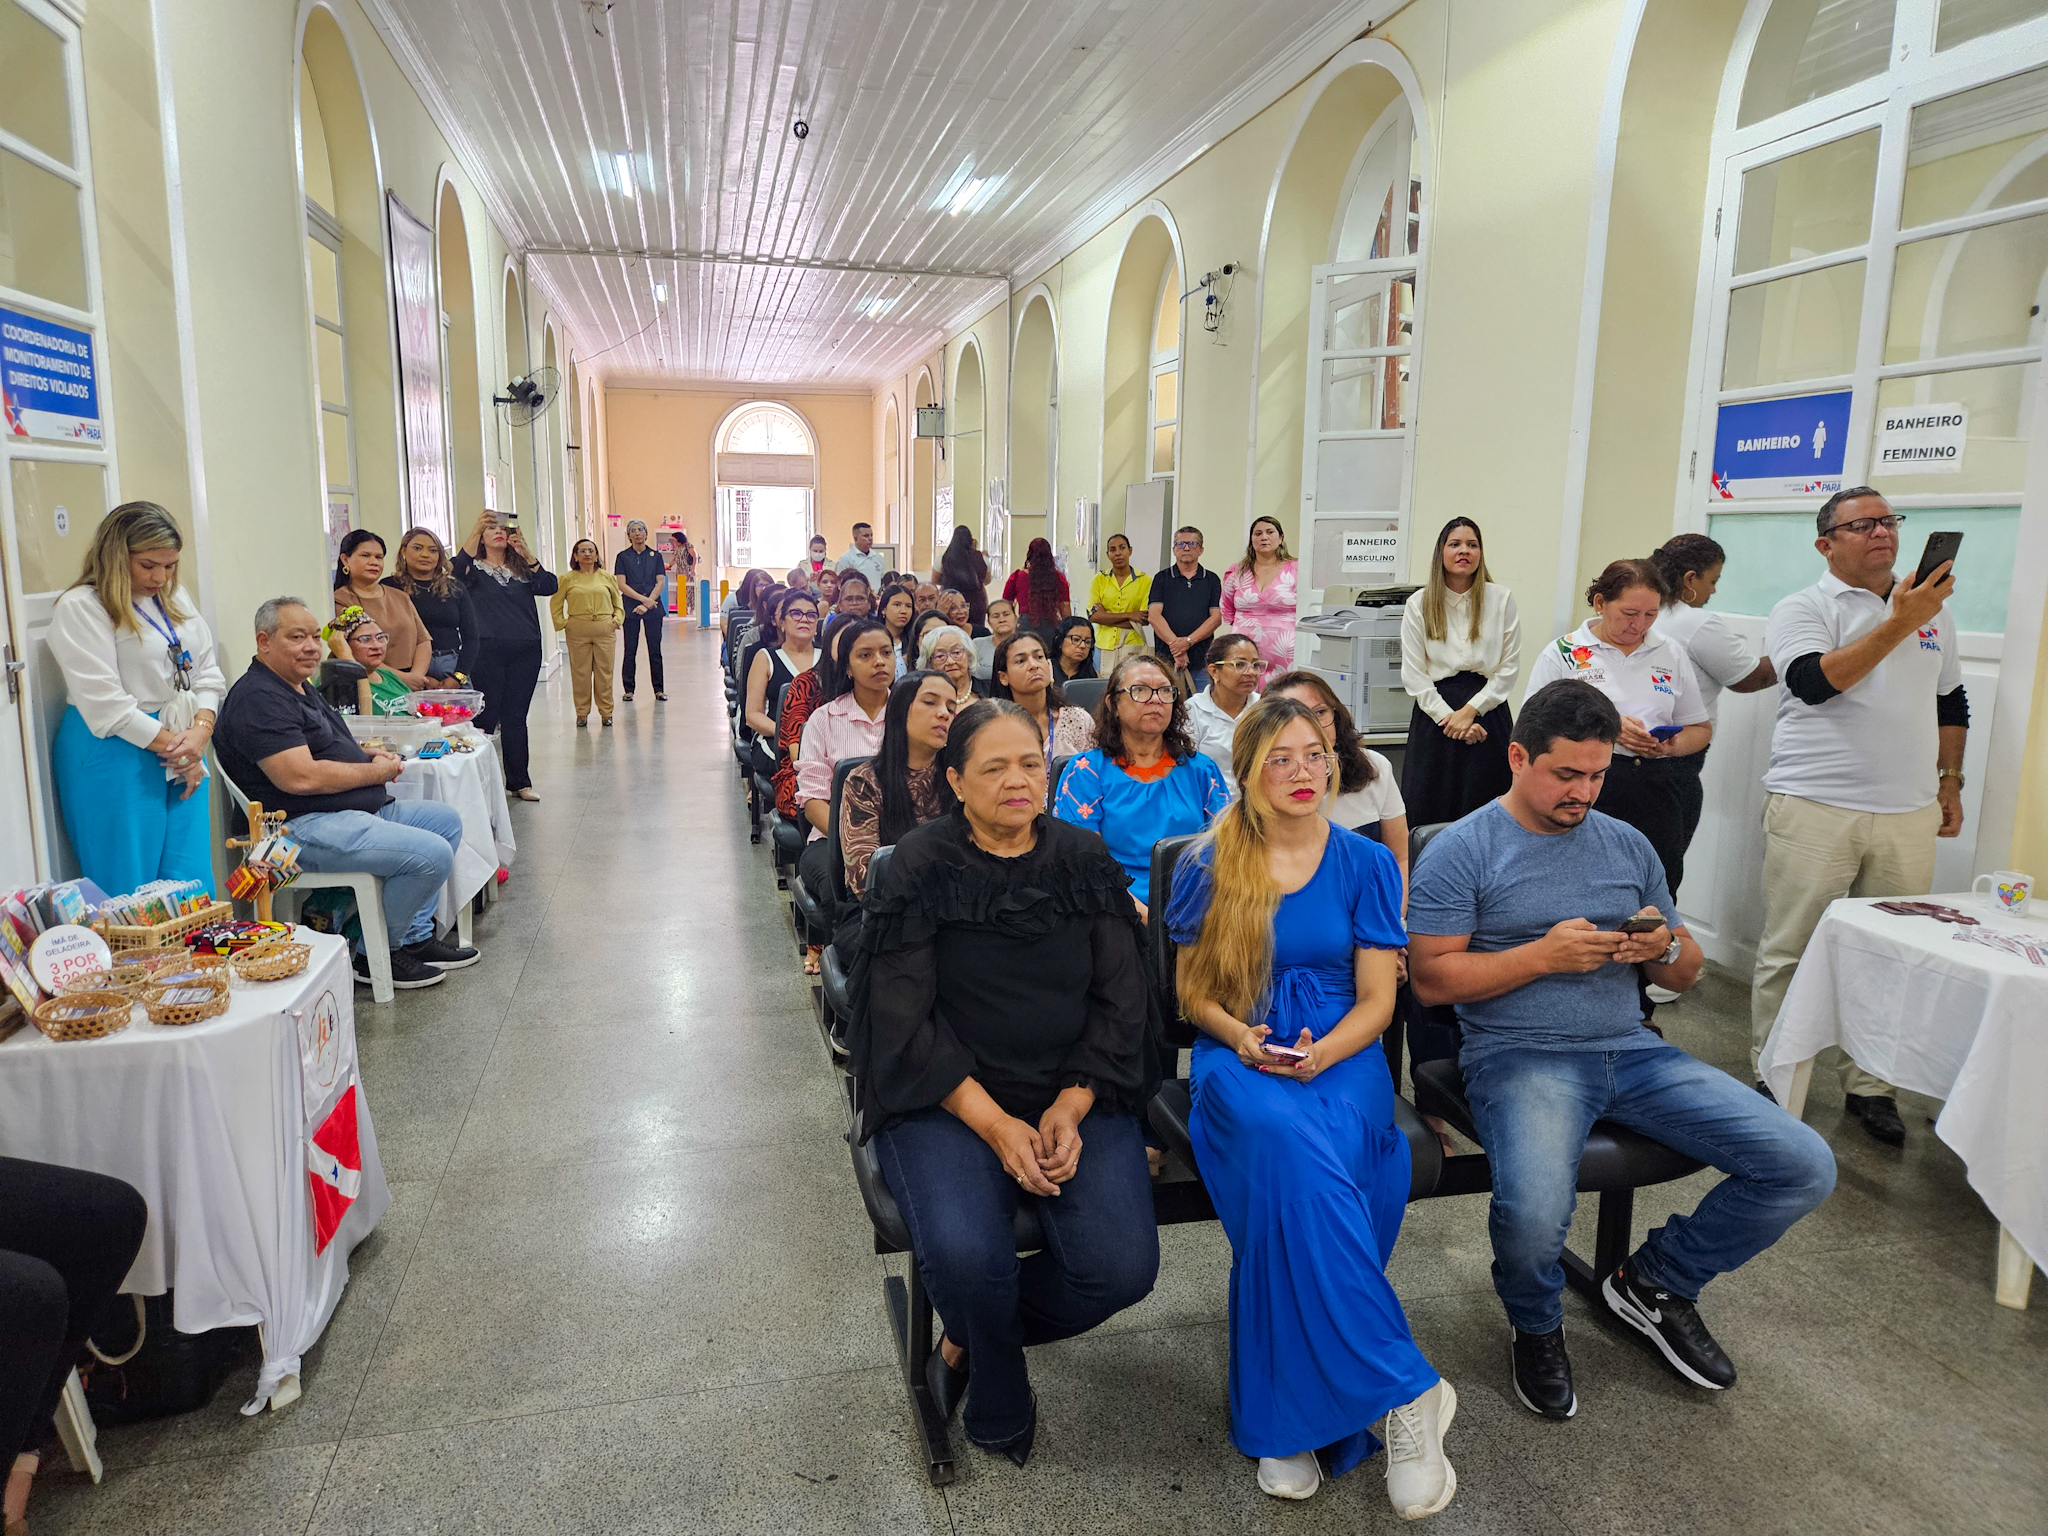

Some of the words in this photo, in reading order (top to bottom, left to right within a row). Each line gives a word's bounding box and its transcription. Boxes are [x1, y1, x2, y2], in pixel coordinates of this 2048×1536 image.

[2, 323, 78, 355] COORDENADORIA
[77, 343, 89, 359] DE
[3, 346, 81, 377] MONITORAMENTO
[81, 364, 92, 379] DE
[9, 370, 49, 391] DIREITOS
[50, 378, 89, 399] VIOLADOS
[1886, 414, 1963, 431] BANHEIRO
[1736, 434, 1801, 452] BANHEIRO
[1883, 446, 1957, 460] FEMININO
[1347, 538, 1397, 546] BANHEIRO
[67, 933, 80, 942] DE
[45, 940, 92, 957] GELADEIRA
[50, 962, 61, 975] 3
[63, 952, 99, 972] POR
